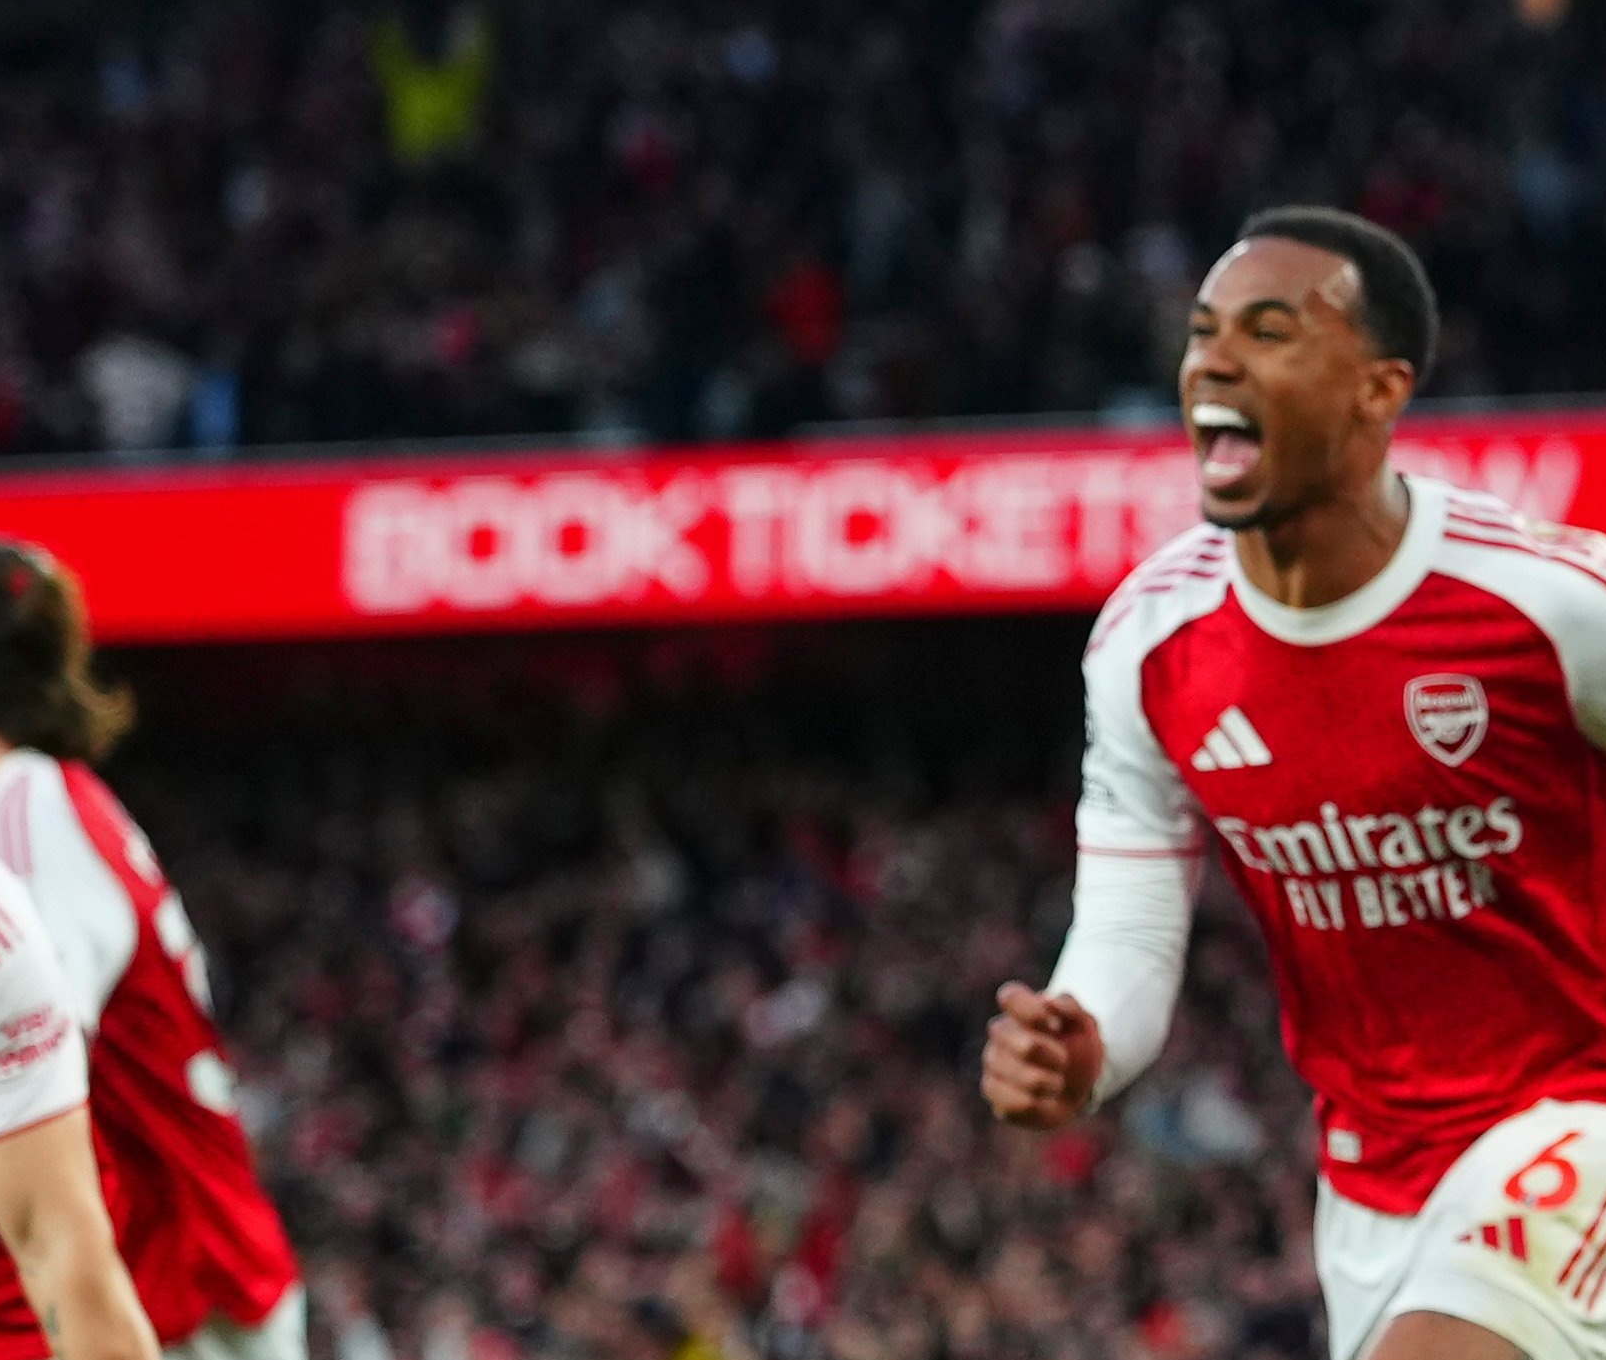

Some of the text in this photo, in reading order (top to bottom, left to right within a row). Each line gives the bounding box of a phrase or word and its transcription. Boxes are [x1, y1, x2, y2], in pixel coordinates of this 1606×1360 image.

[341, 451, 1198, 616] BOOK TICKETS
[1214, 796, 1523, 875] Emirates
[1353, 859, 1498, 929] BETTER
[1504, 1131, 1581, 1212] 6
